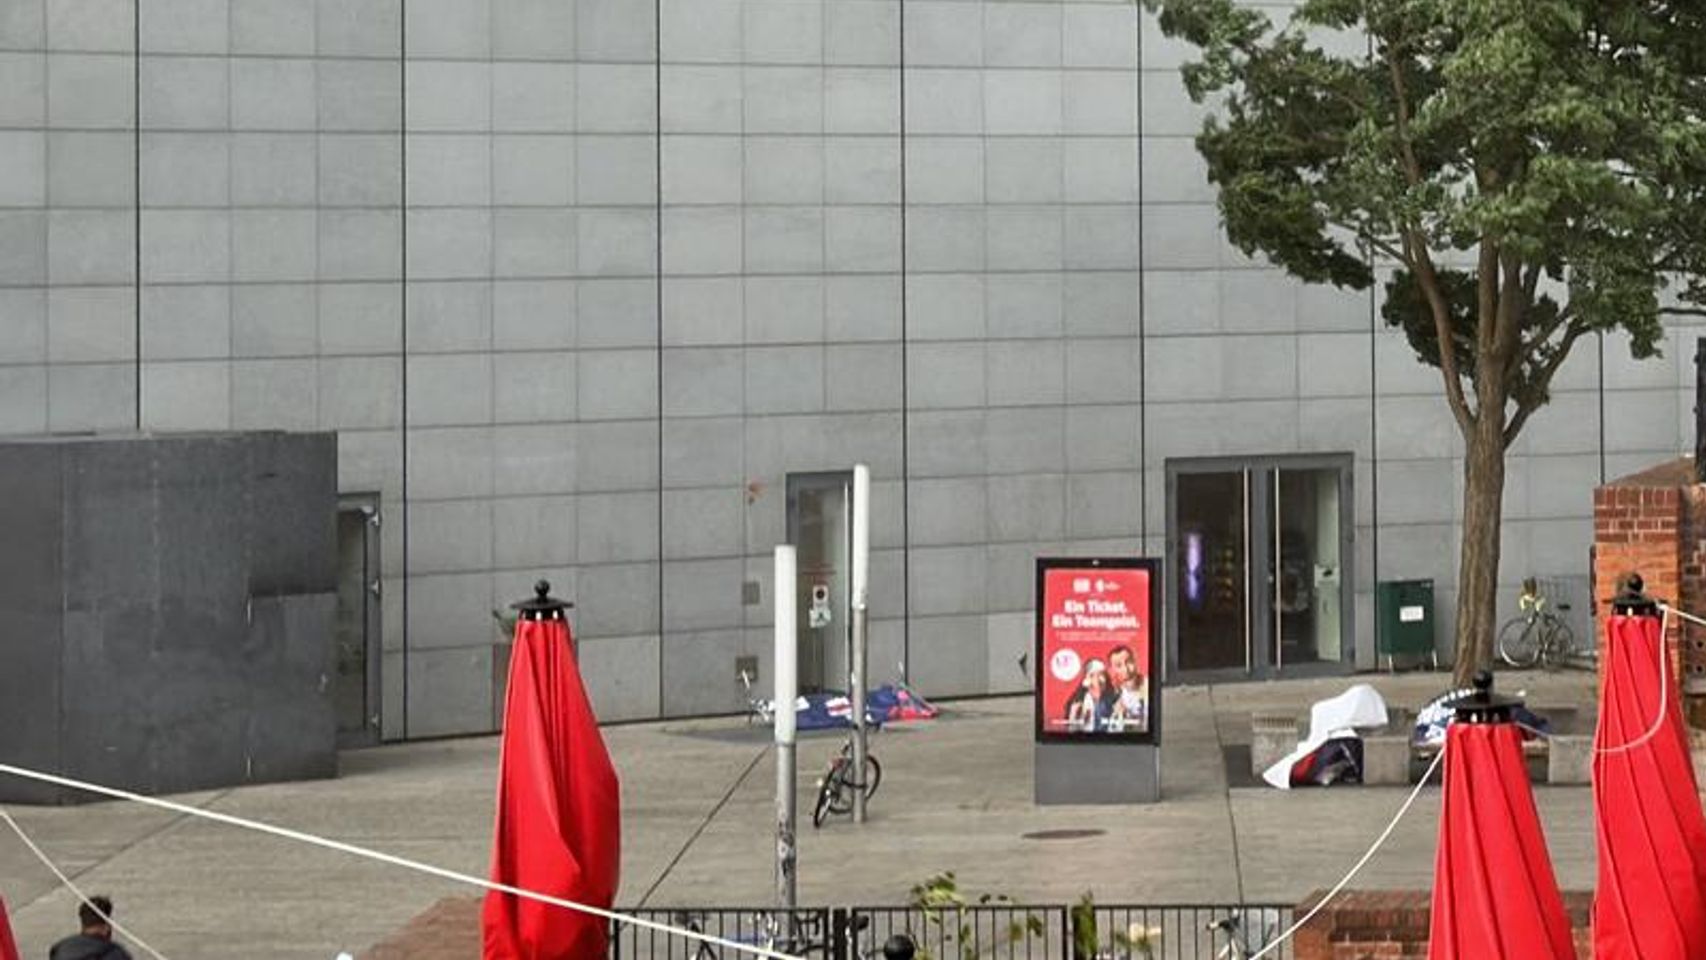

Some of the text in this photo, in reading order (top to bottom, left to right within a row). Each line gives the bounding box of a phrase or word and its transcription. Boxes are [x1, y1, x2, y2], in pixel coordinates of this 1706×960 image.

[1064, 600, 1127, 613] Ein Ticket.
[1052, 615, 1140, 630] Ein Teamgeist.
